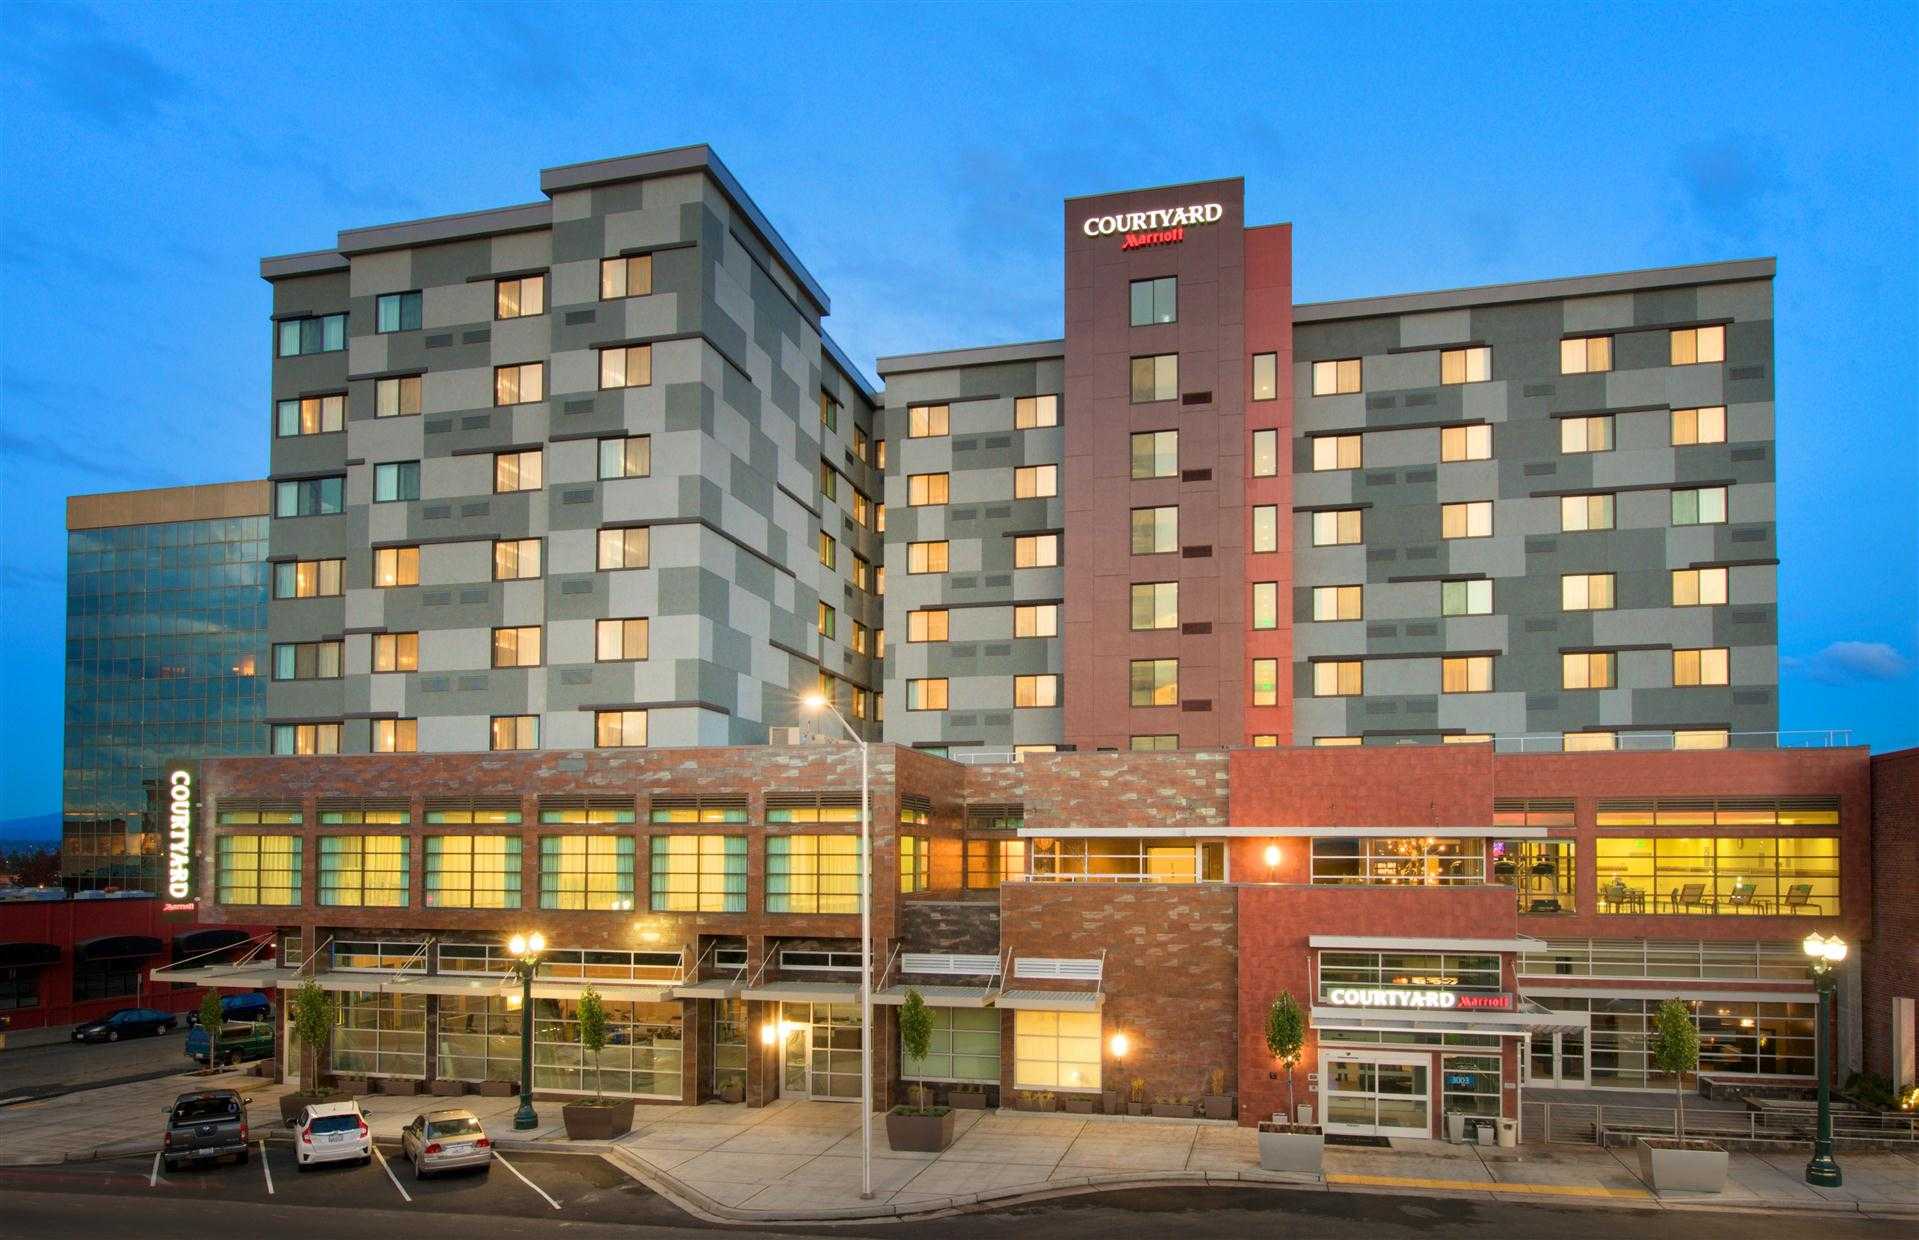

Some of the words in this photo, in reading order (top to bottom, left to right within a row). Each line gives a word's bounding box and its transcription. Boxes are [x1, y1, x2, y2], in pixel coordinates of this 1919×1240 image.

[1084, 203, 1223, 236] COURTYARD
[1121, 227, 1184, 250] Marriott
[169, 770, 190, 899] COURTYARD
[1330, 989, 1456, 1008] COURTYARD
[1457, 996, 1509, 1009] Marriott
